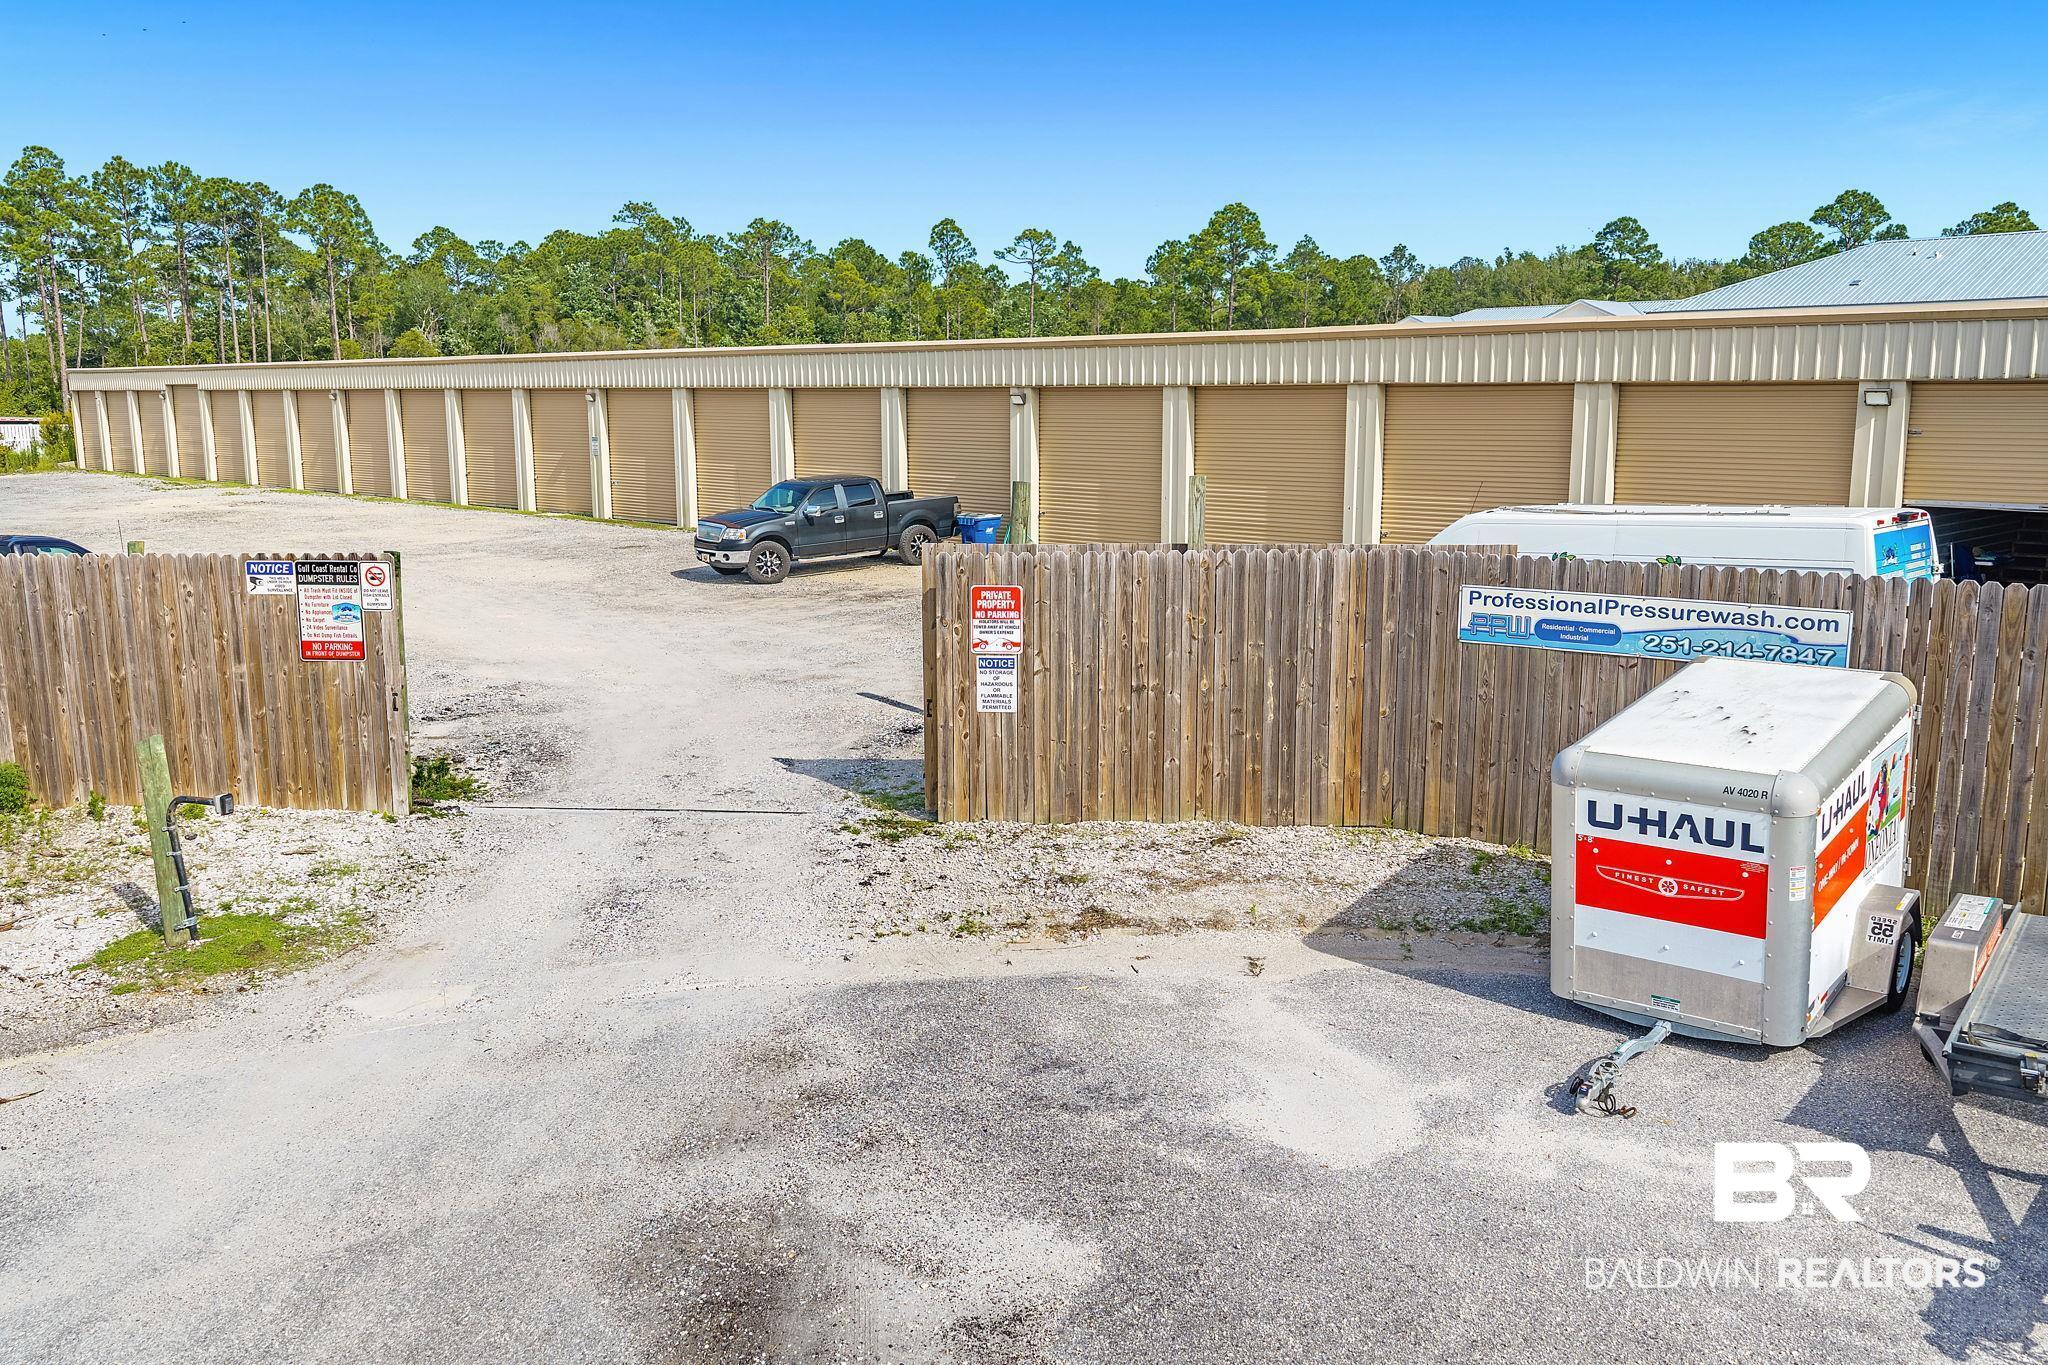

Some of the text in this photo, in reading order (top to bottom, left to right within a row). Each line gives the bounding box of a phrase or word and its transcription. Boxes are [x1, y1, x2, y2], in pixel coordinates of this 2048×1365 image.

[250, 564, 290, 574] NOTICE
[311, 564, 328, 573] Coast
[330, 564, 348, 573] Rental
[350, 564, 358, 573] Co
[298, 574, 334, 582] DUMPSTER
[981, 590, 1011, 600] PRIVATE
[977, 600, 1015, 609] PROPERTY
[1469, 590, 1840, 633] ProfessionalPressurewash.com
[1541, 622, 1616, 635] Residential Commercial
[1560, 634, 1589, 642] Industrial
[1643, 635, 1836, 667] 251-214-7847
[1722, 786, 1768, 800] AV 4020 R
[1822, 770, 1866, 840] U-HAUL
[1588, 800, 1764, 854] U-HAUL
[1614, 872, 1654, 884] FINEST
[1683, 884, 1725, 896] SAFEST
